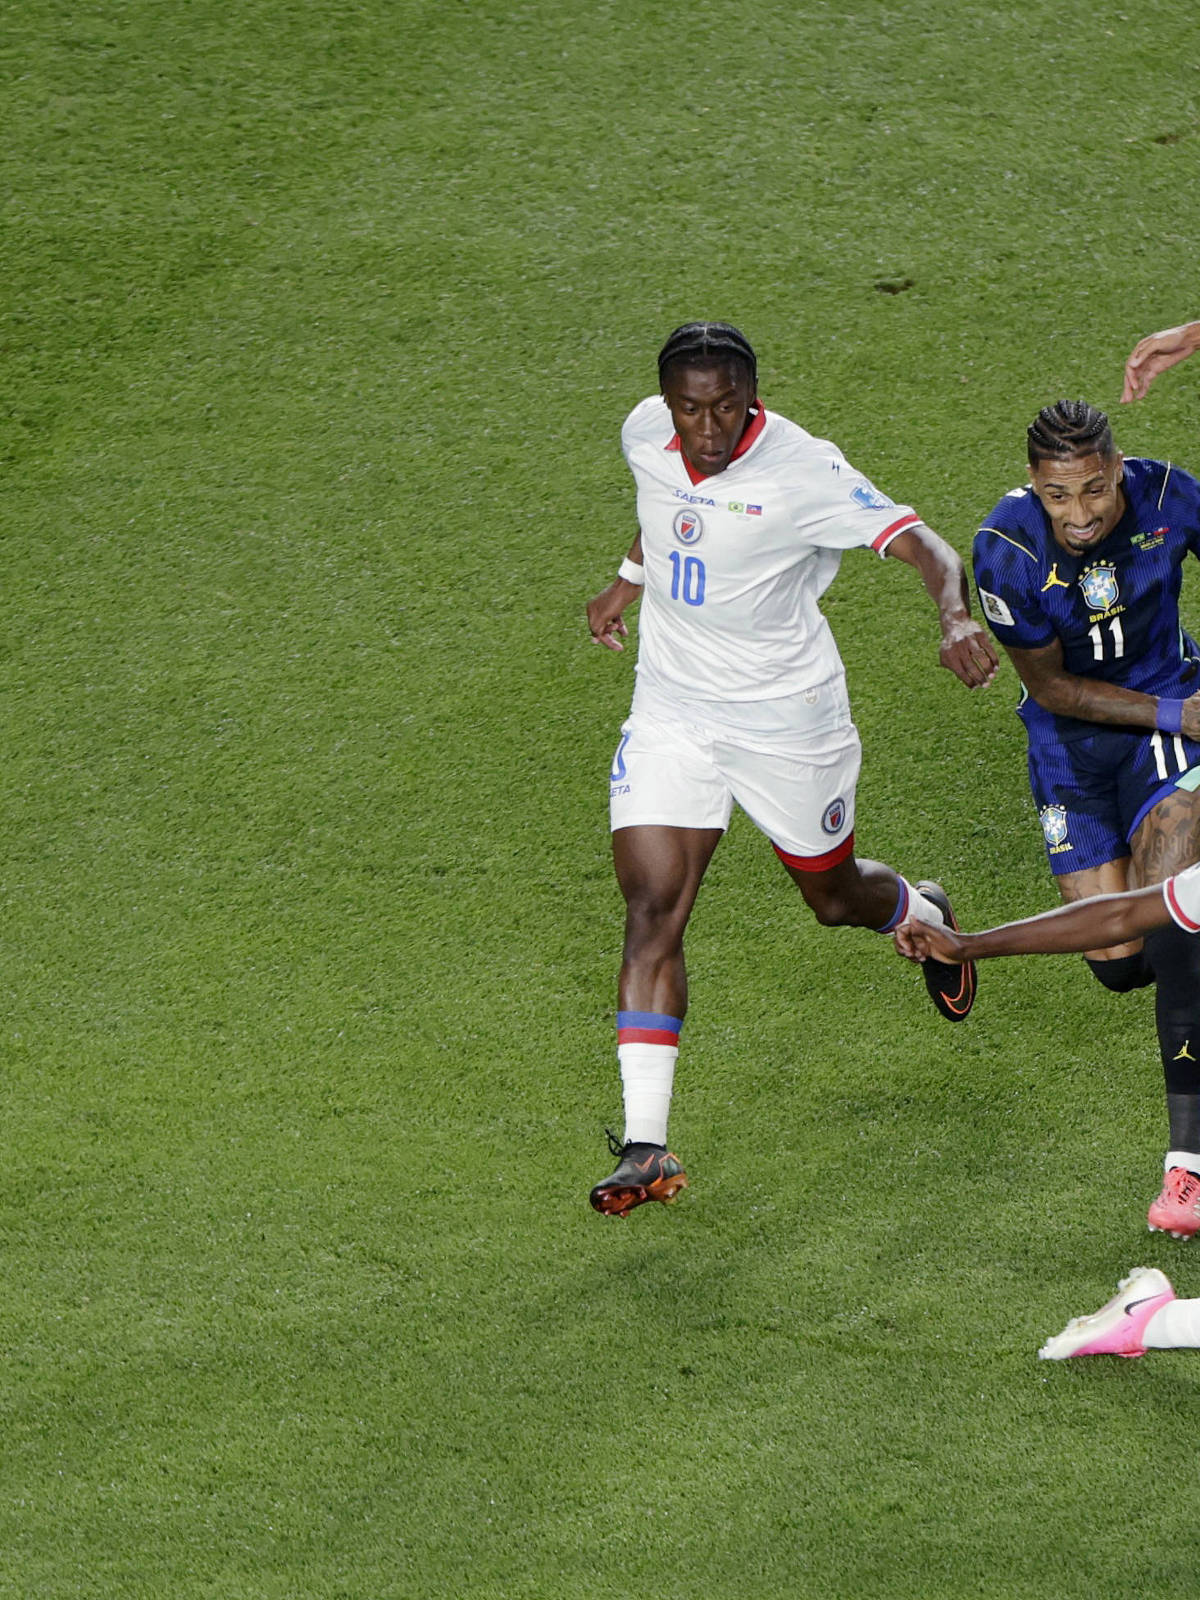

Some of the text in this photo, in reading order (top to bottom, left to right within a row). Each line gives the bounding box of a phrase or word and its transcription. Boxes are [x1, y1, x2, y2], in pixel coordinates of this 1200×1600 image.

[668, 550, 706, 606] 10
[1089, 604, 1126, 623] BRASIL
[1088, 616, 1124, 661] 11
[1150, 730, 1188, 780] 11
